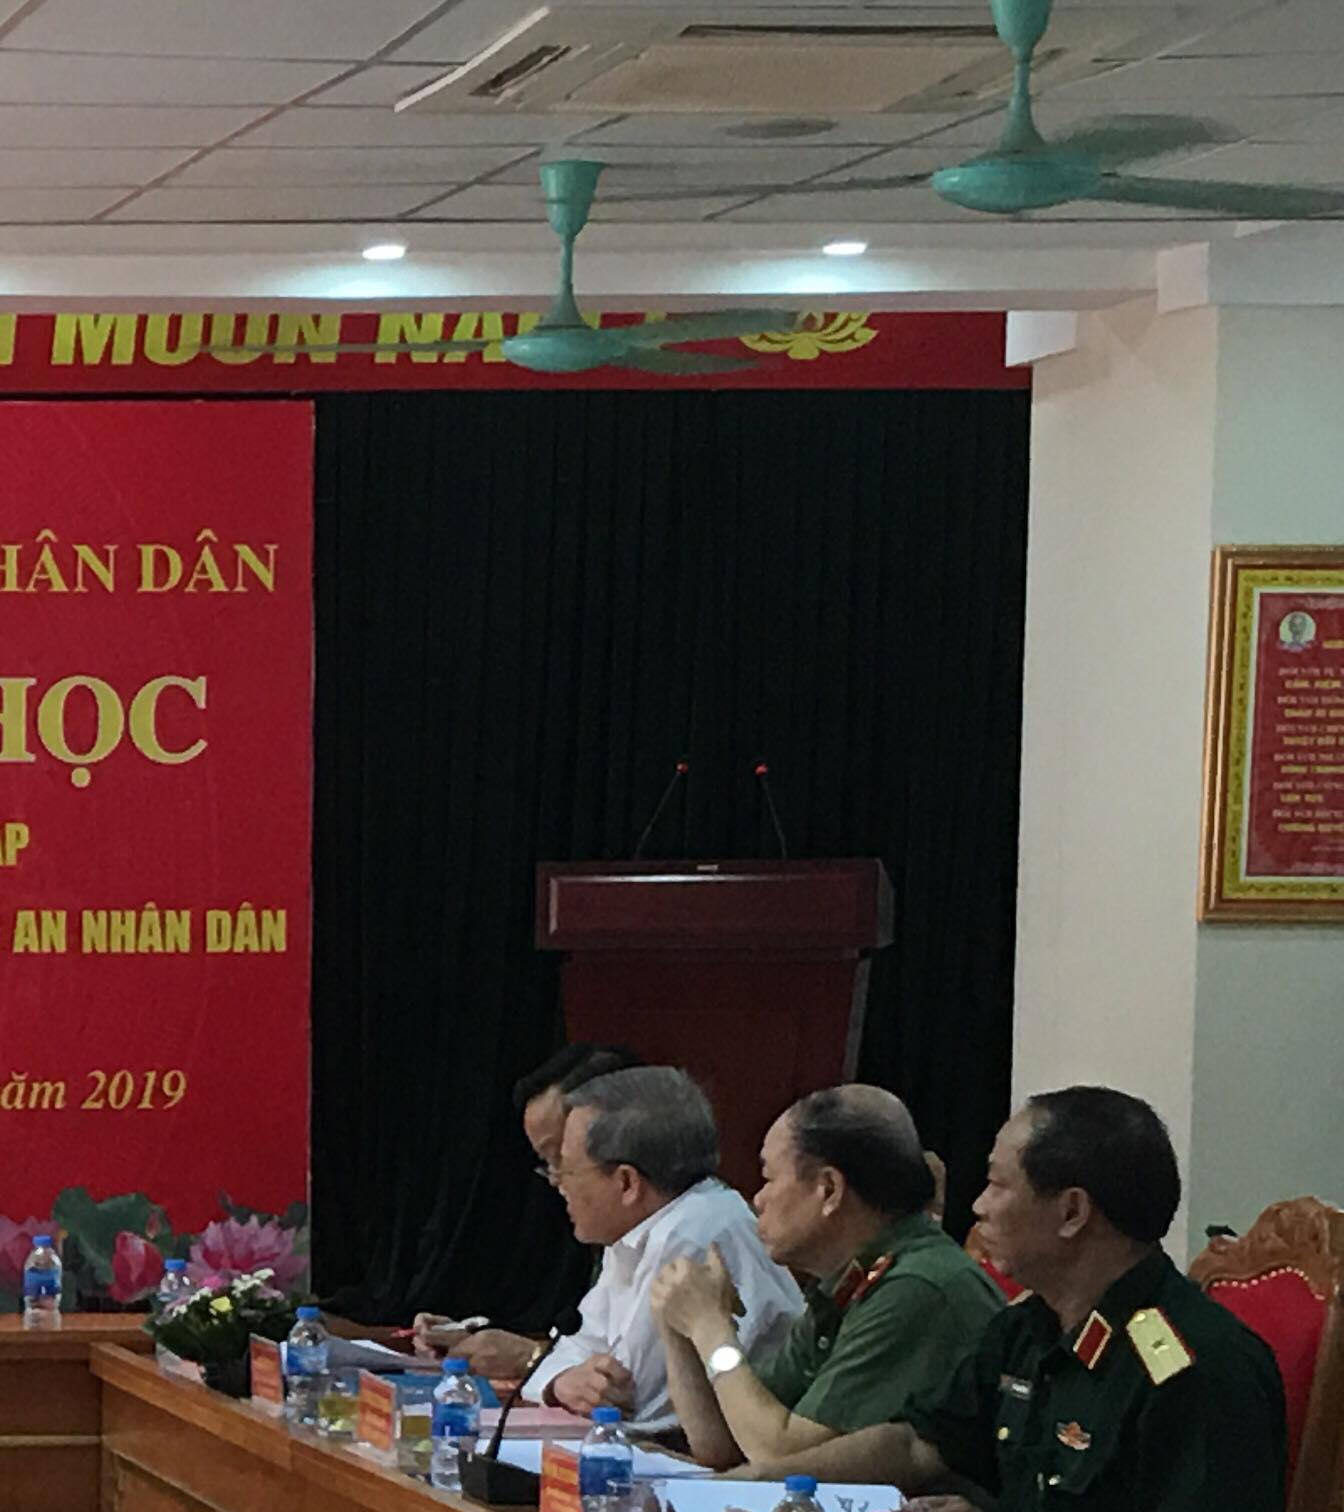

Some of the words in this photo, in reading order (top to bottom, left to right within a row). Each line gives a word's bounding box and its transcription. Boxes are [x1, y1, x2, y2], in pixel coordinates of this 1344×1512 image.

[136, 528, 279, 593] DÂN
[12, 910, 68, 955] AN
[81, 901, 192, 954] NHÂN
[205, 901, 288, 954] DÂN
[80, 1069, 188, 1110] 2019
